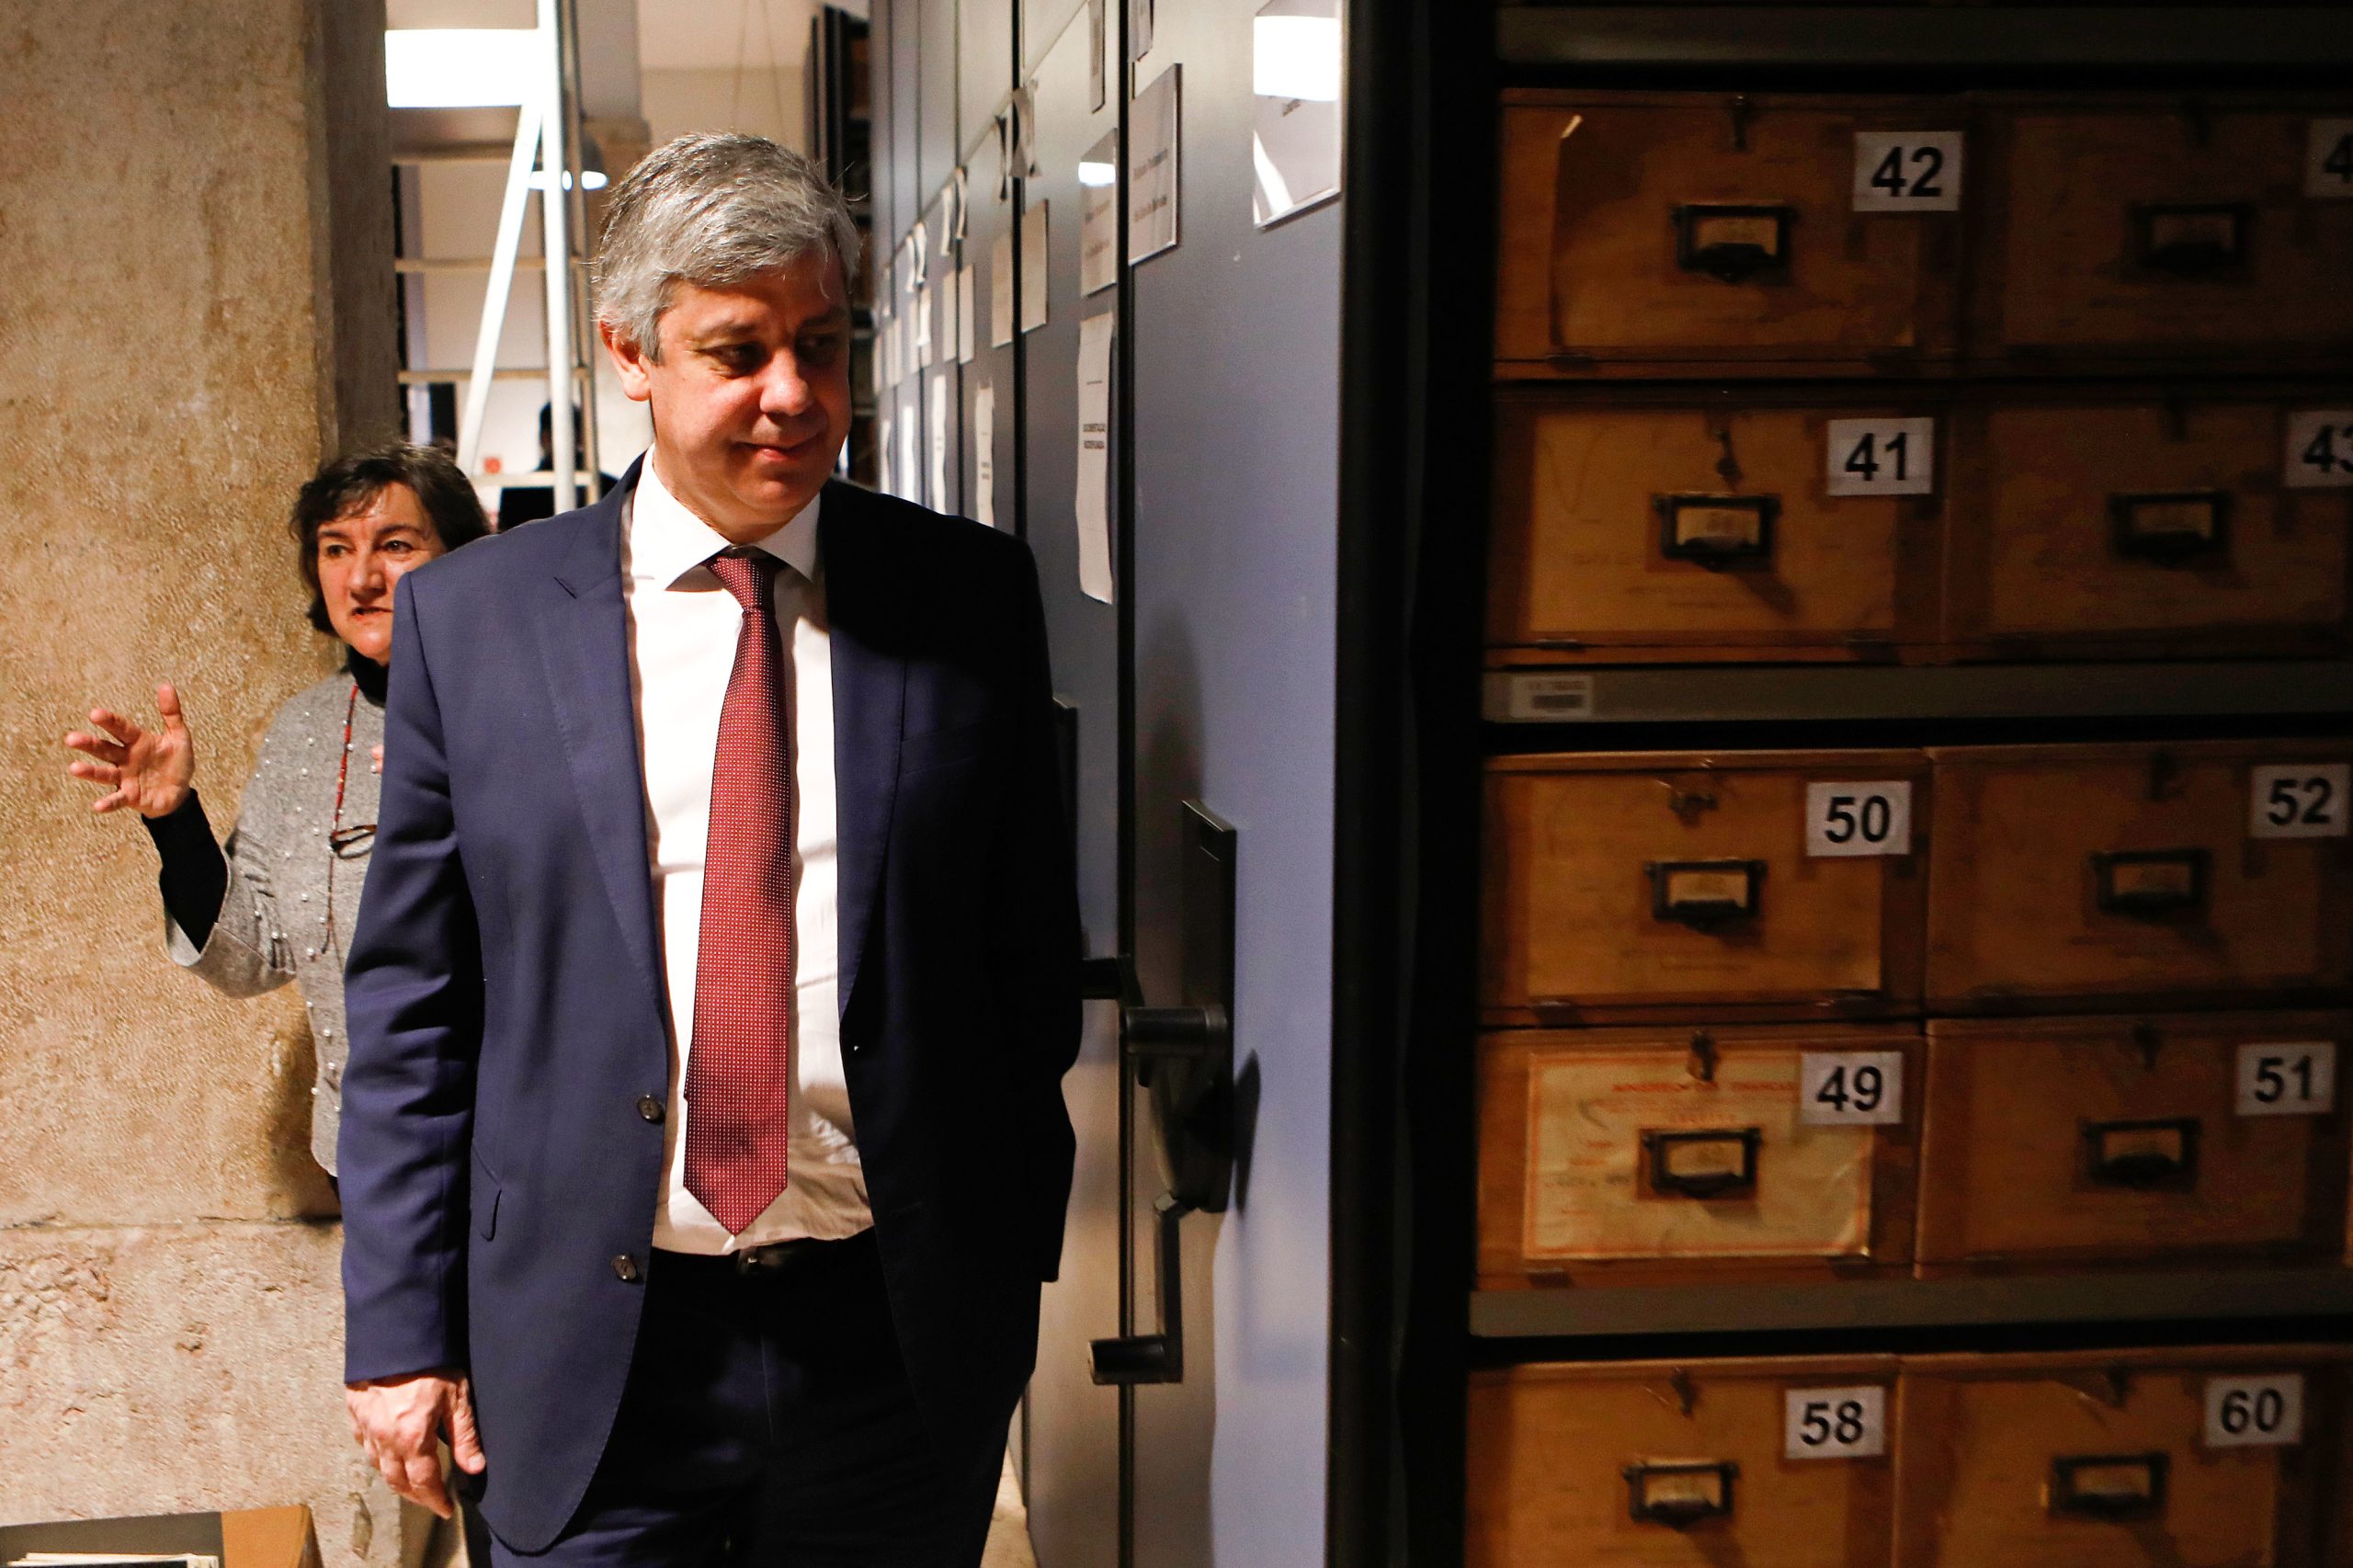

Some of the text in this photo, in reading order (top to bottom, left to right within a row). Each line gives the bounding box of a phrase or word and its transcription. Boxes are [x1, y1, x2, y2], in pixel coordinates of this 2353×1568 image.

[1870, 146, 1944, 198] 42
[1844, 431, 1908, 482] 41
[1824, 794, 1891, 844] 50
[2268, 776, 2333, 826] 52
[1816, 1065, 1883, 1112] 49
[2254, 1054, 2313, 1104] 51
[1801, 1400, 1864, 1447] 58
[2220, 1387, 2285, 1435] 60
